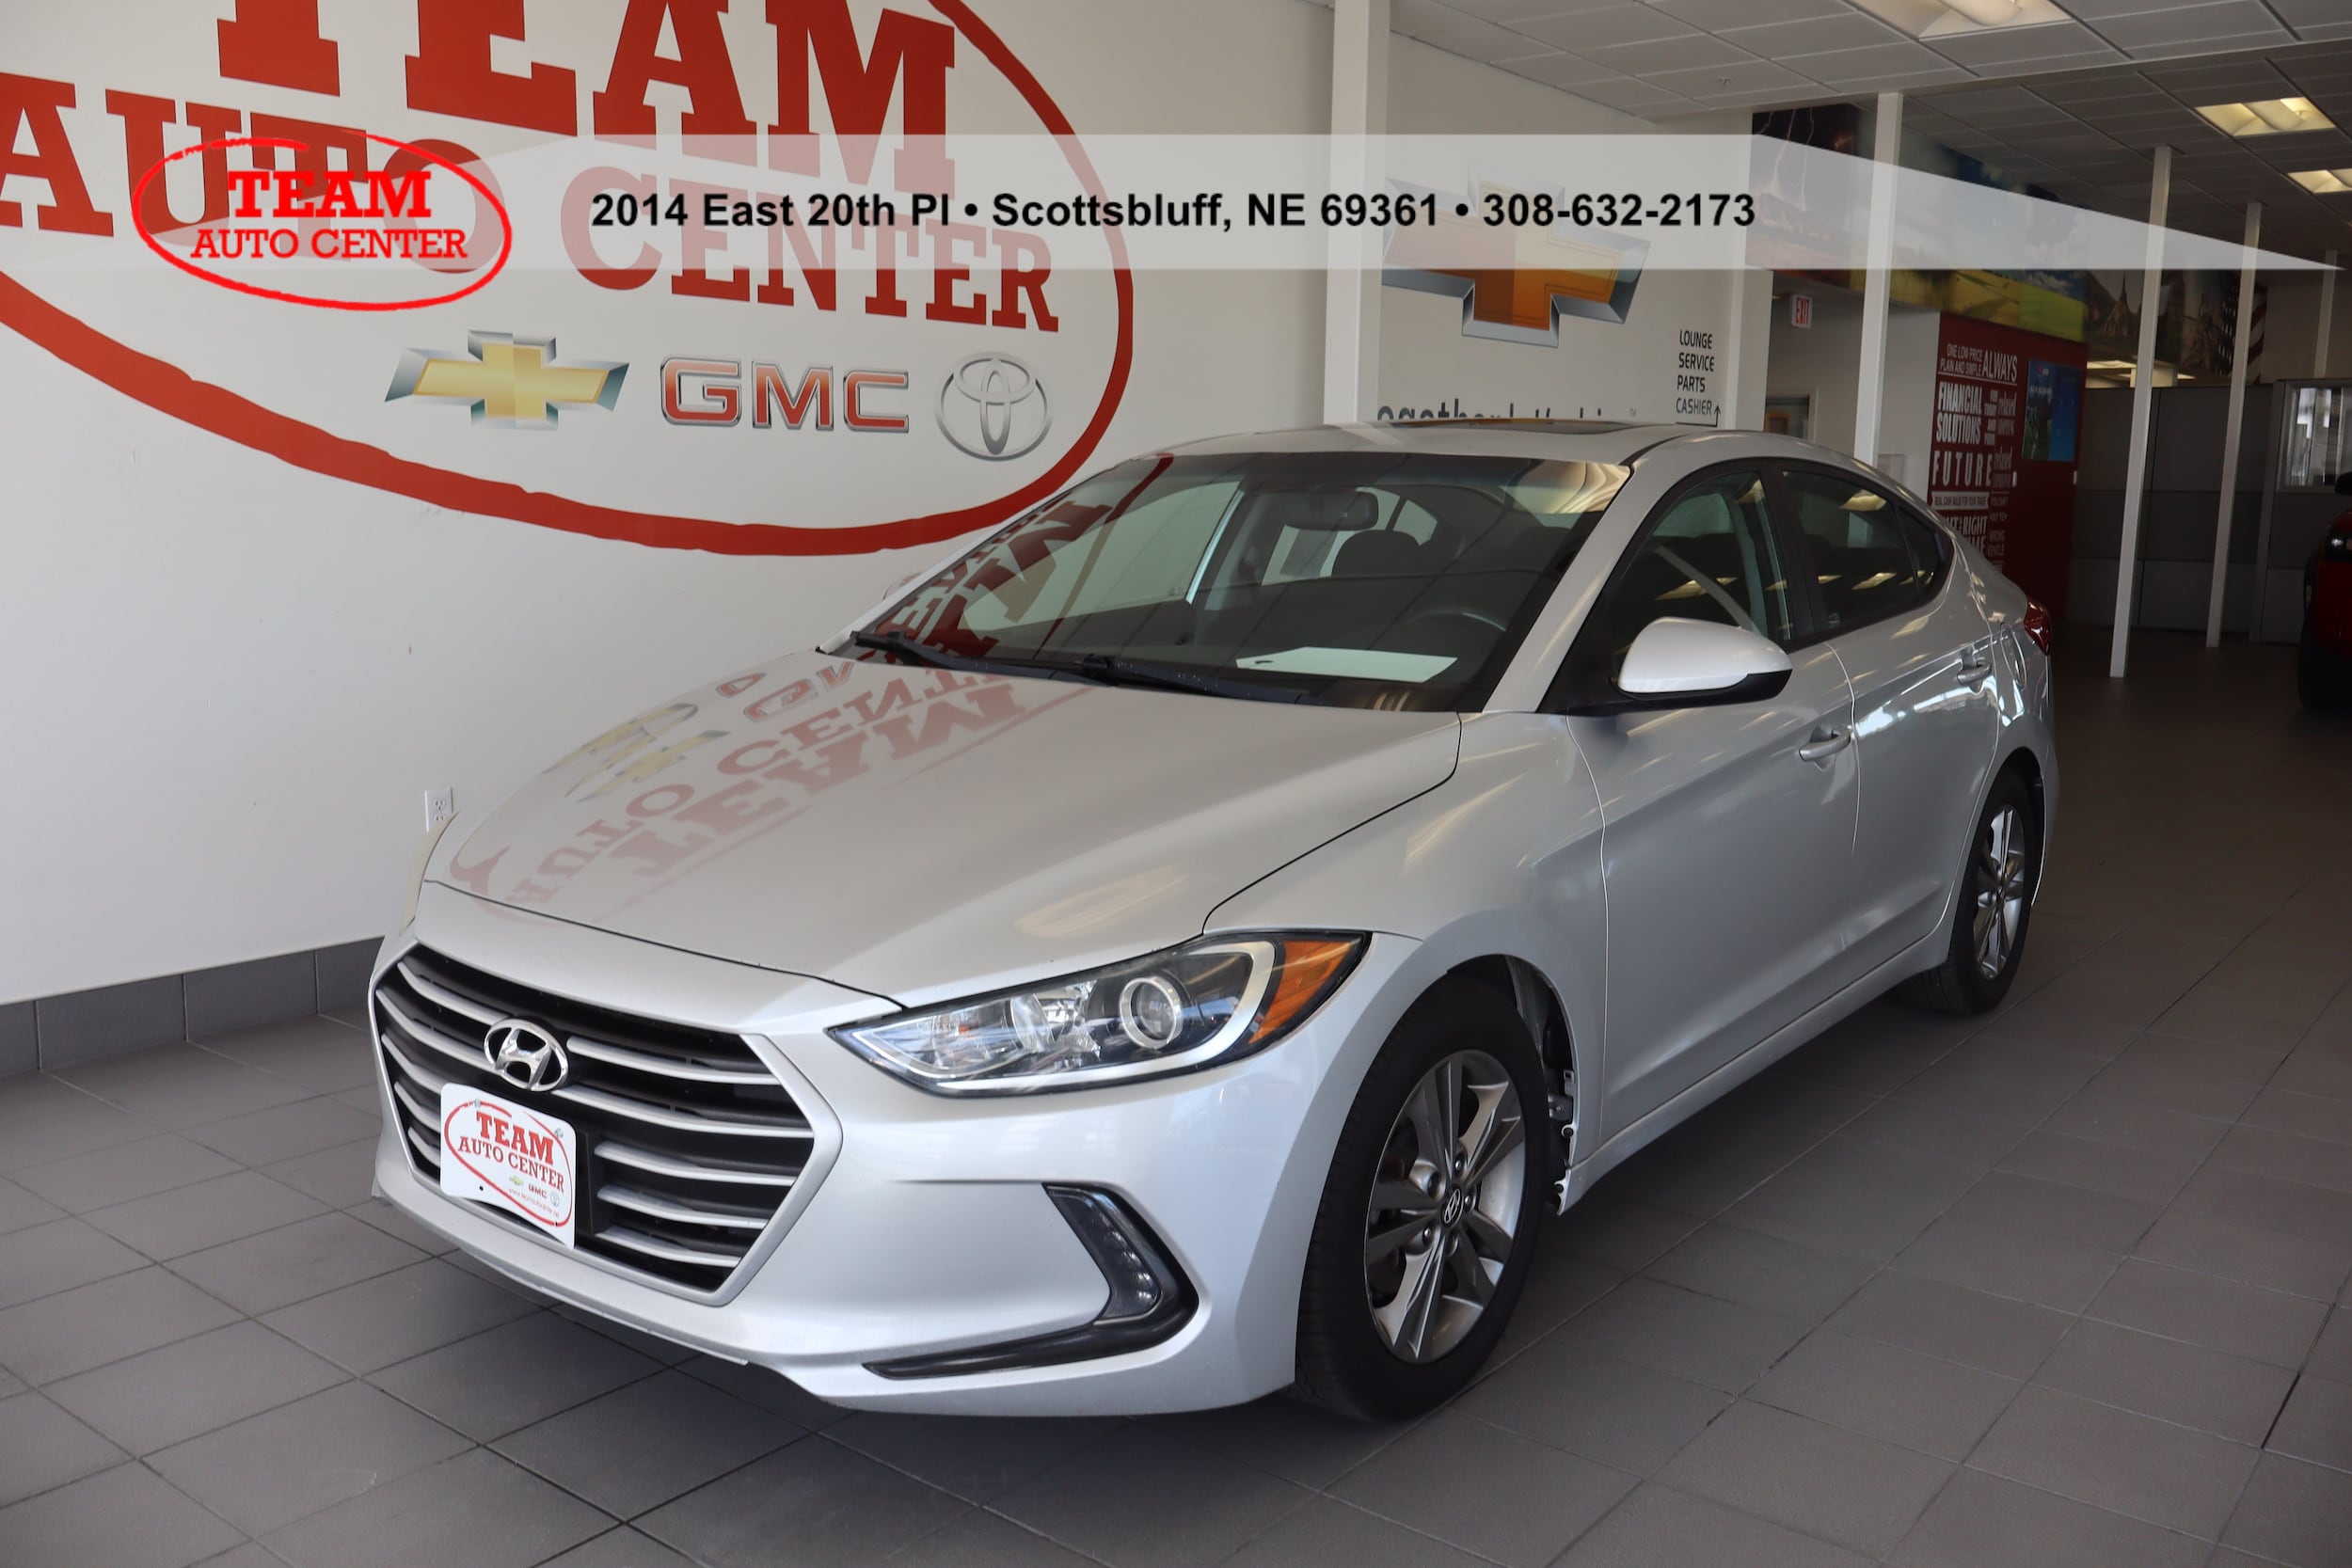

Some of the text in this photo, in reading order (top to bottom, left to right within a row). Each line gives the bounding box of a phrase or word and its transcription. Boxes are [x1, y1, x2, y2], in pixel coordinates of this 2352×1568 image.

[0, 71, 1059, 333] AUTO CENTER
[1795, 296, 1810, 325] EXIT
[1679, 329, 1712, 350] LOUNGE
[1678, 352, 1715, 372] SERVICE
[1981, 349, 2018, 383] ALWAYS
[660, 355, 910, 434] GMC
[1677, 374, 1706, 393] PARTS
[1938, 381, 1982, 416] FINANCIAL
[1676, 397, 1712, 416] CASHIER
[1936, 412, 1981, 445] SOLUTIONS
[1932, 450, 1994, 486] FUTURE
[1963, 515, 1988, 536] RIGHT
[476, 1110, 553, 1164] TEAM
[458, 1135, 564, 1193] AUTO CENTER
[528, 1183, 548, 1198] GMC
